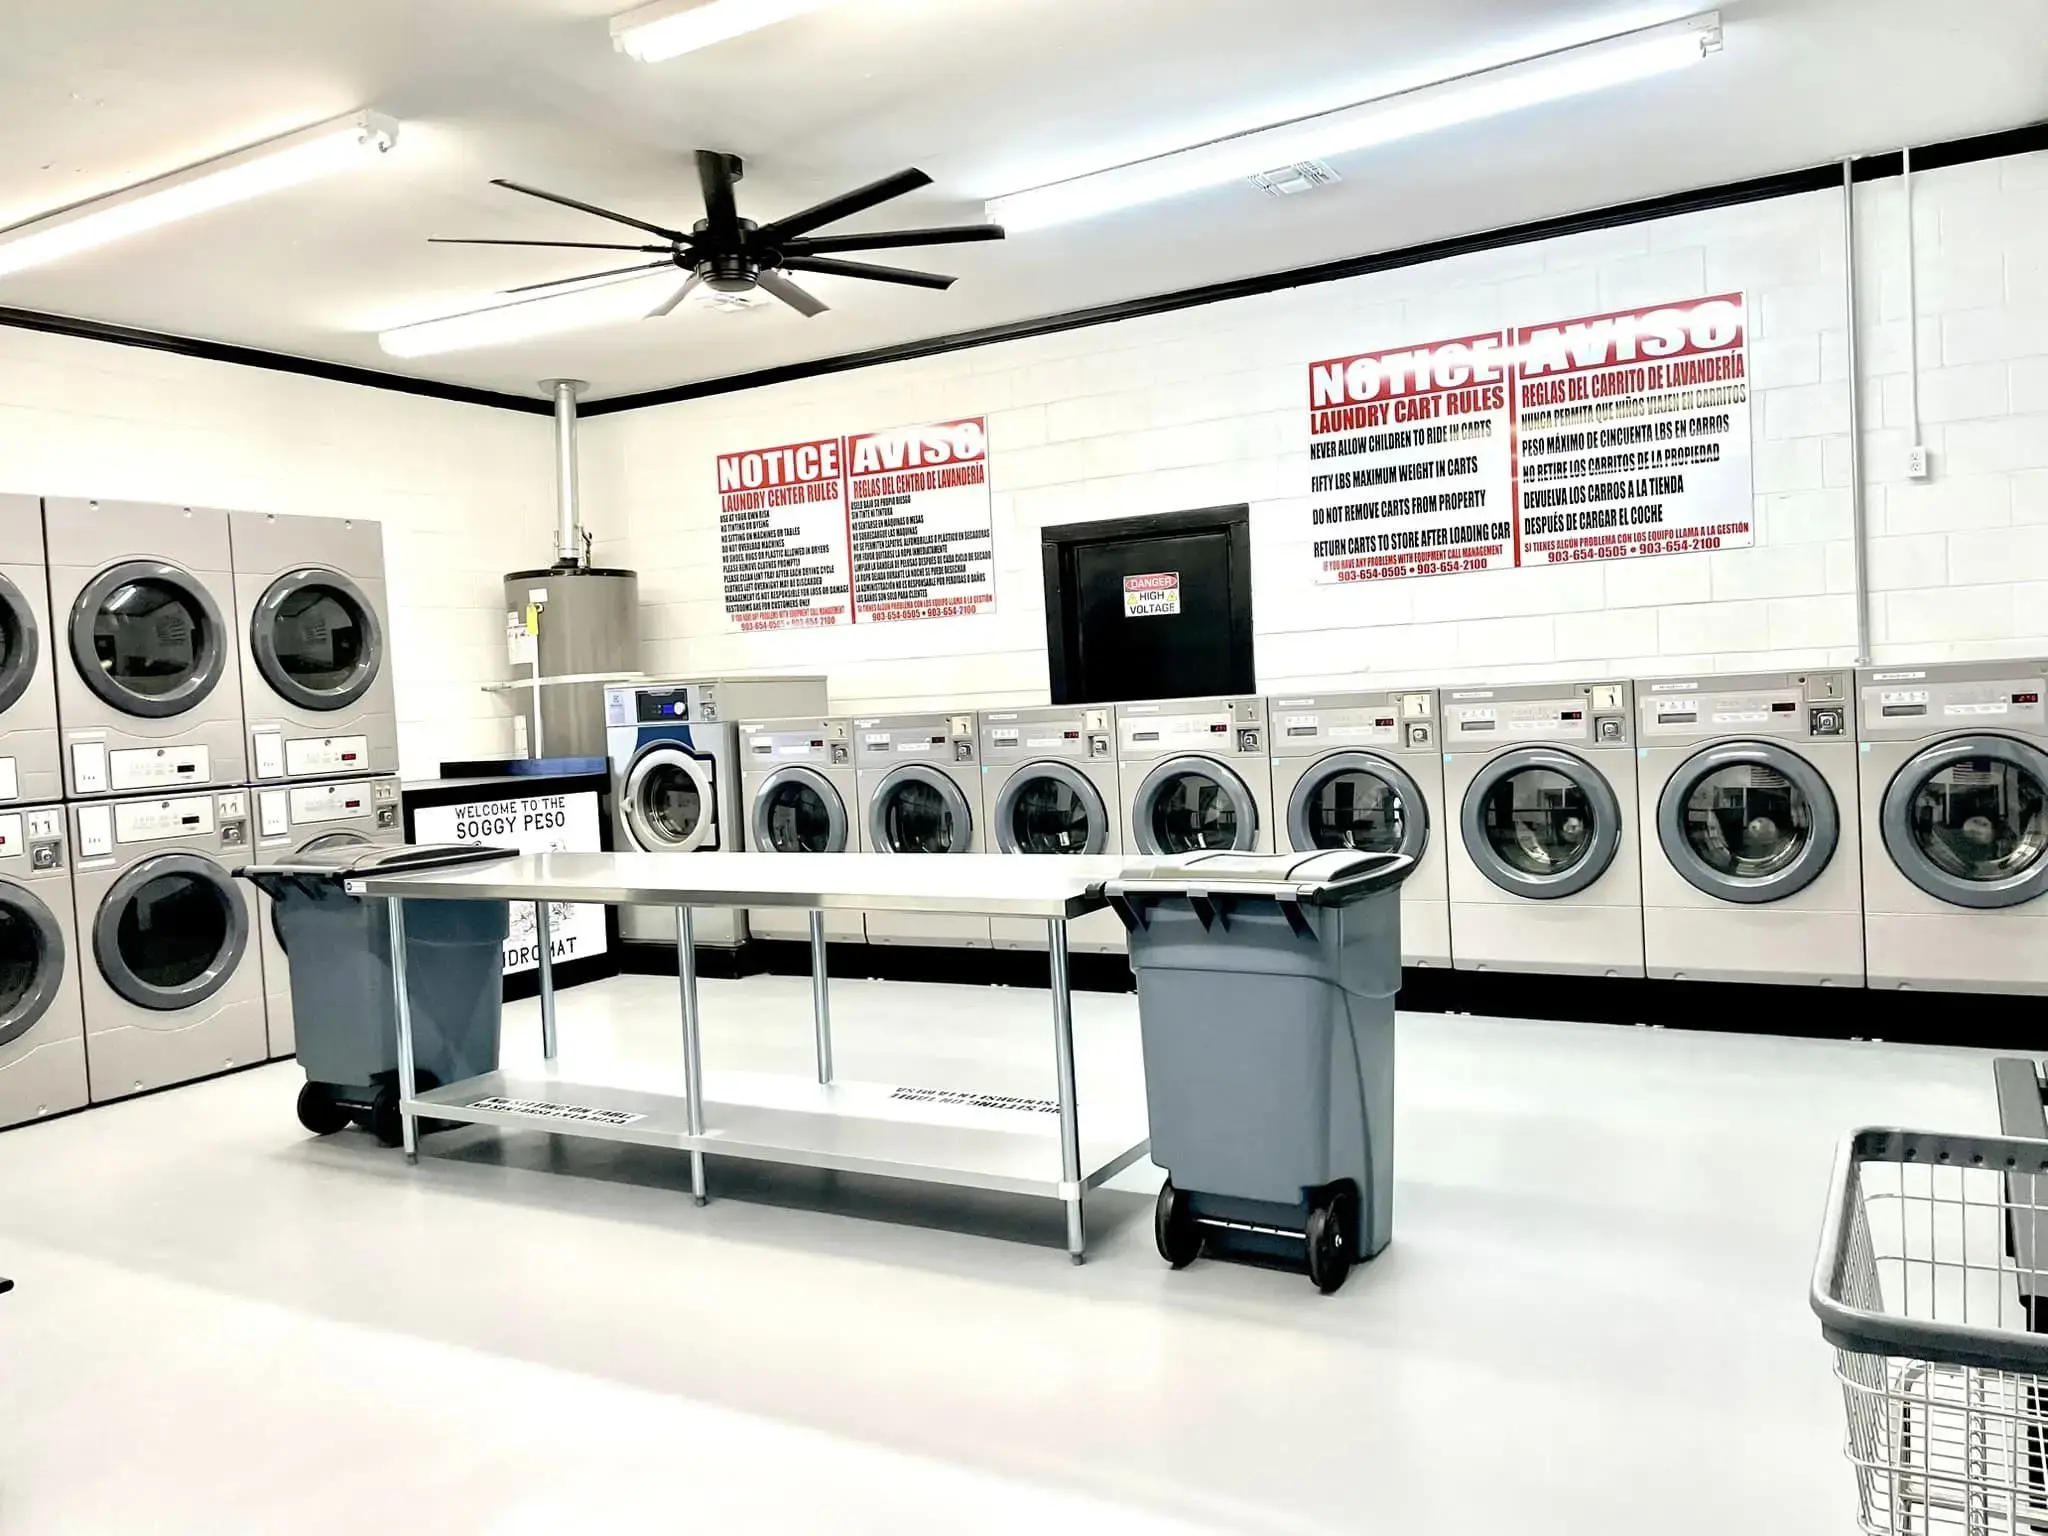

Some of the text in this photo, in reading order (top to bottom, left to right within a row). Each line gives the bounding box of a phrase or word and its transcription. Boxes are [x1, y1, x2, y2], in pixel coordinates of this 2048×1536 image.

[1312, 337, 1500, 407] NOTICE
[1522, 351, 1744, 408] REGLAS DEL CARRITO DE LAVANDERÍA
[1311, 386, 1504, 435] LAUNDRY CART RULES
[1522, 385, 1746, 431] NUNCA PERMITA QUE NIÑOS VIAJEN EN CARRITOS
[852, 422, 982, 474] AVISO
[1310, 420, 1492, 460] NEVER ALLOW CHILDREN TO RIDE IN CARTS
[1522, 414, 1729, 457] PESO MÁXIMO DE CINCUENTA LBS EN CARROS
[719, 443, 837, 491] NOTICE
[854, 463, 984, 498] REGLAS DEL CENTRO DE LAVANDERÍA
[1312, 456, 1478, 492] FIFTY LBS MAXIMUM WEIGHT IN CARTS
[1523, 443, 1720, 483] NO RETIRE LOS CARRITOS DE LA PROPIEDAD
[722, 482, 838, 512] LAUNDRY CENTER RULES
[1313, 490, 1485, 525] DO NOT REMOVE CARTS FROM PROPERTY
[1524, 475, 1684, 509] DEVUELVA LOS CARROS A LA TIENDA
[1525, 504, 1663, 535] DESPUÉS DE CARGAR EL COCHE
[1314, 522, 1510, 557] RETURN CARTS TO STORE AFTER LOADING CAR
[1548, 537, 1720, 562] 903-654-0505 903-654-2100
[1131, 577, 1170, 588] DANGER
[1338, 558, 1487, 581] 903-654-0505 903-654-2100
[1129, 603, 1175, 614] VOLTAGE
[1139, 591, 1165, 601] HIGH
[455, 796, 565, 819] WELCOME TO THE
[456, 811, 566, 839] SOGGY PESO
